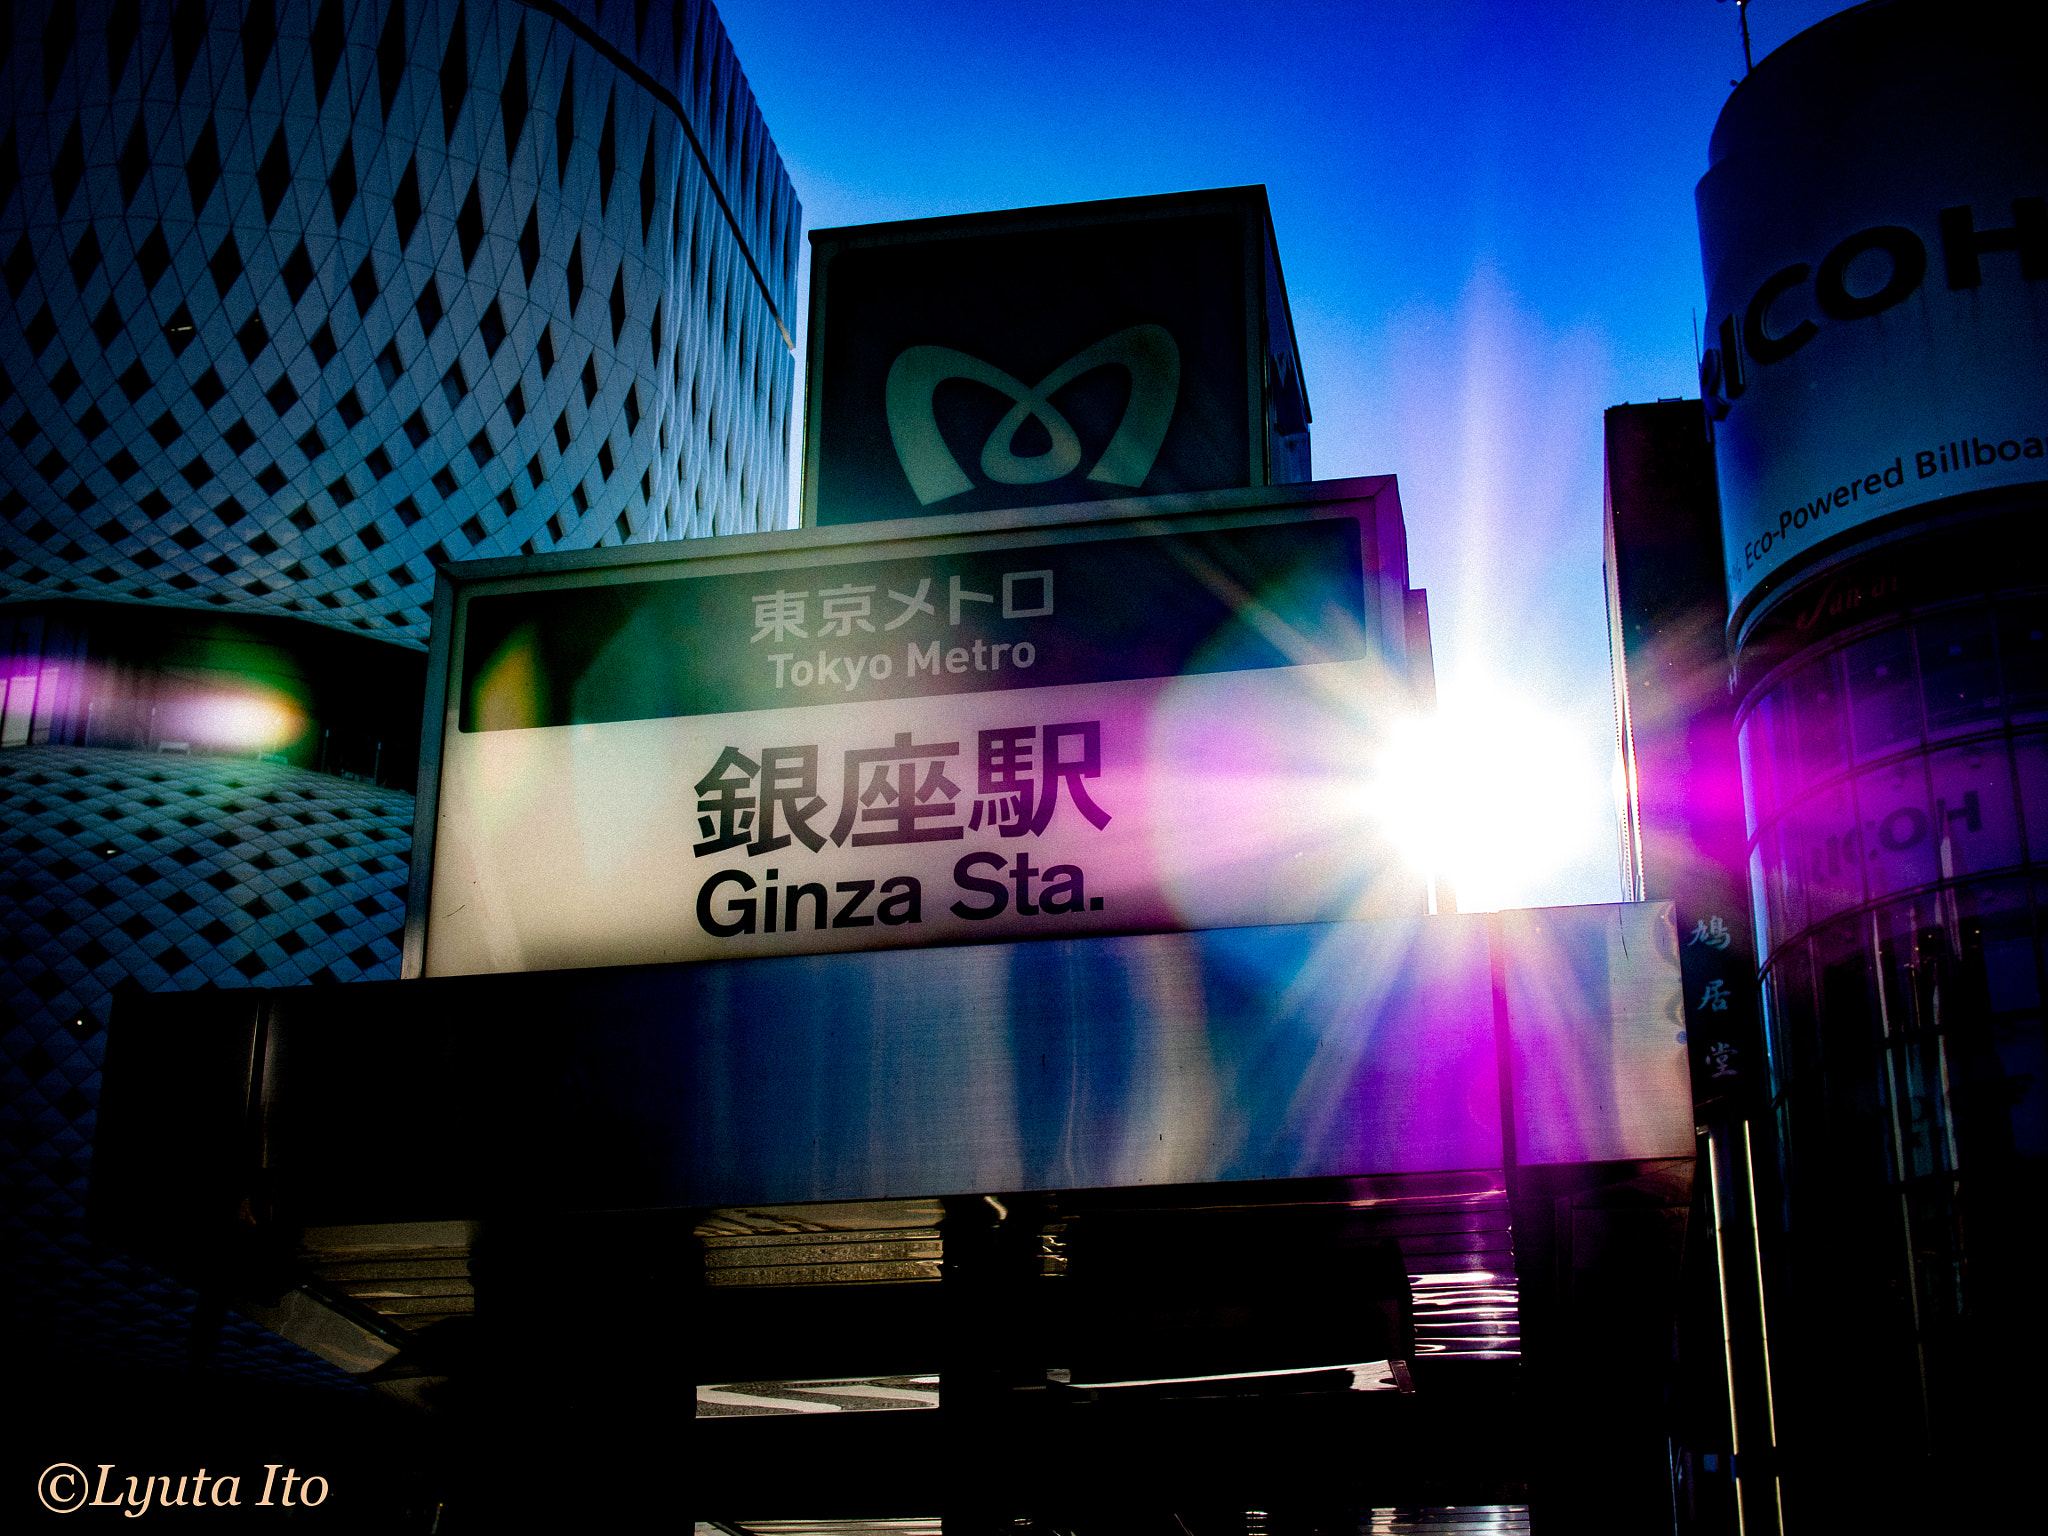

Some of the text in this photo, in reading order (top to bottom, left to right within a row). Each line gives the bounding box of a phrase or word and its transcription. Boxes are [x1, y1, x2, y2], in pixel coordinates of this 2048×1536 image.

[1744, 436, 2048, 570] Eco-Powered Billboa
[750, 569, 1054, 643] 東京メトロ
[768, 640, 1036, 692] Tokyo Metro
[693, 720, 1112, 857] 銀座駅
[696, 851, 1104, 938] Ginza Sta.
[1687, 914, 1739, 1079] 鳩居堂
